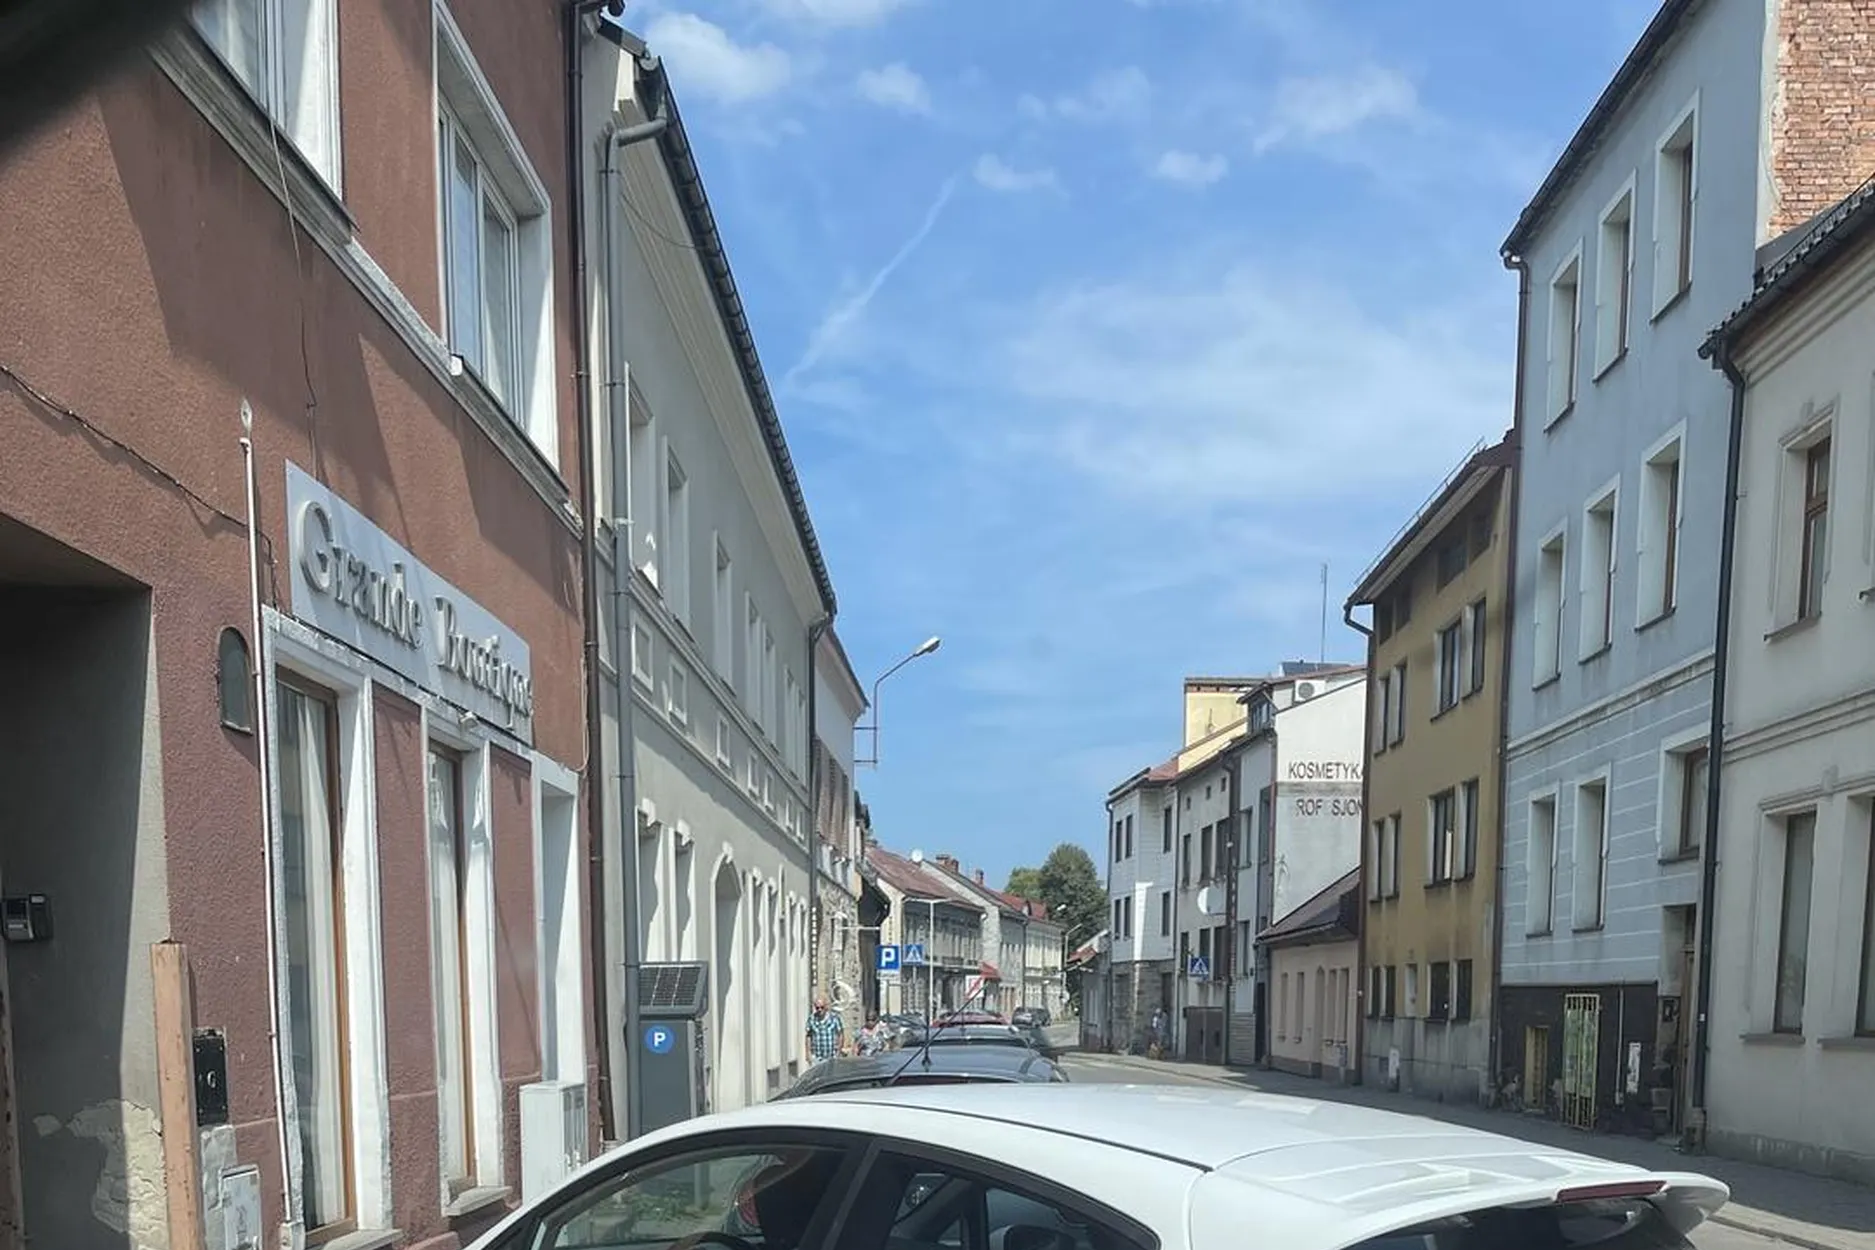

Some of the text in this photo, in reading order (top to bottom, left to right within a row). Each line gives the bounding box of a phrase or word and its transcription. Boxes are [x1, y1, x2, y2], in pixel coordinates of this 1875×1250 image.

[298, 500, 423, 650] Grande
[1288, 762, 1363, 779] KOSMETYK
[881, 948, 896, 967] P
[653, 1031, 666, 1048] P
